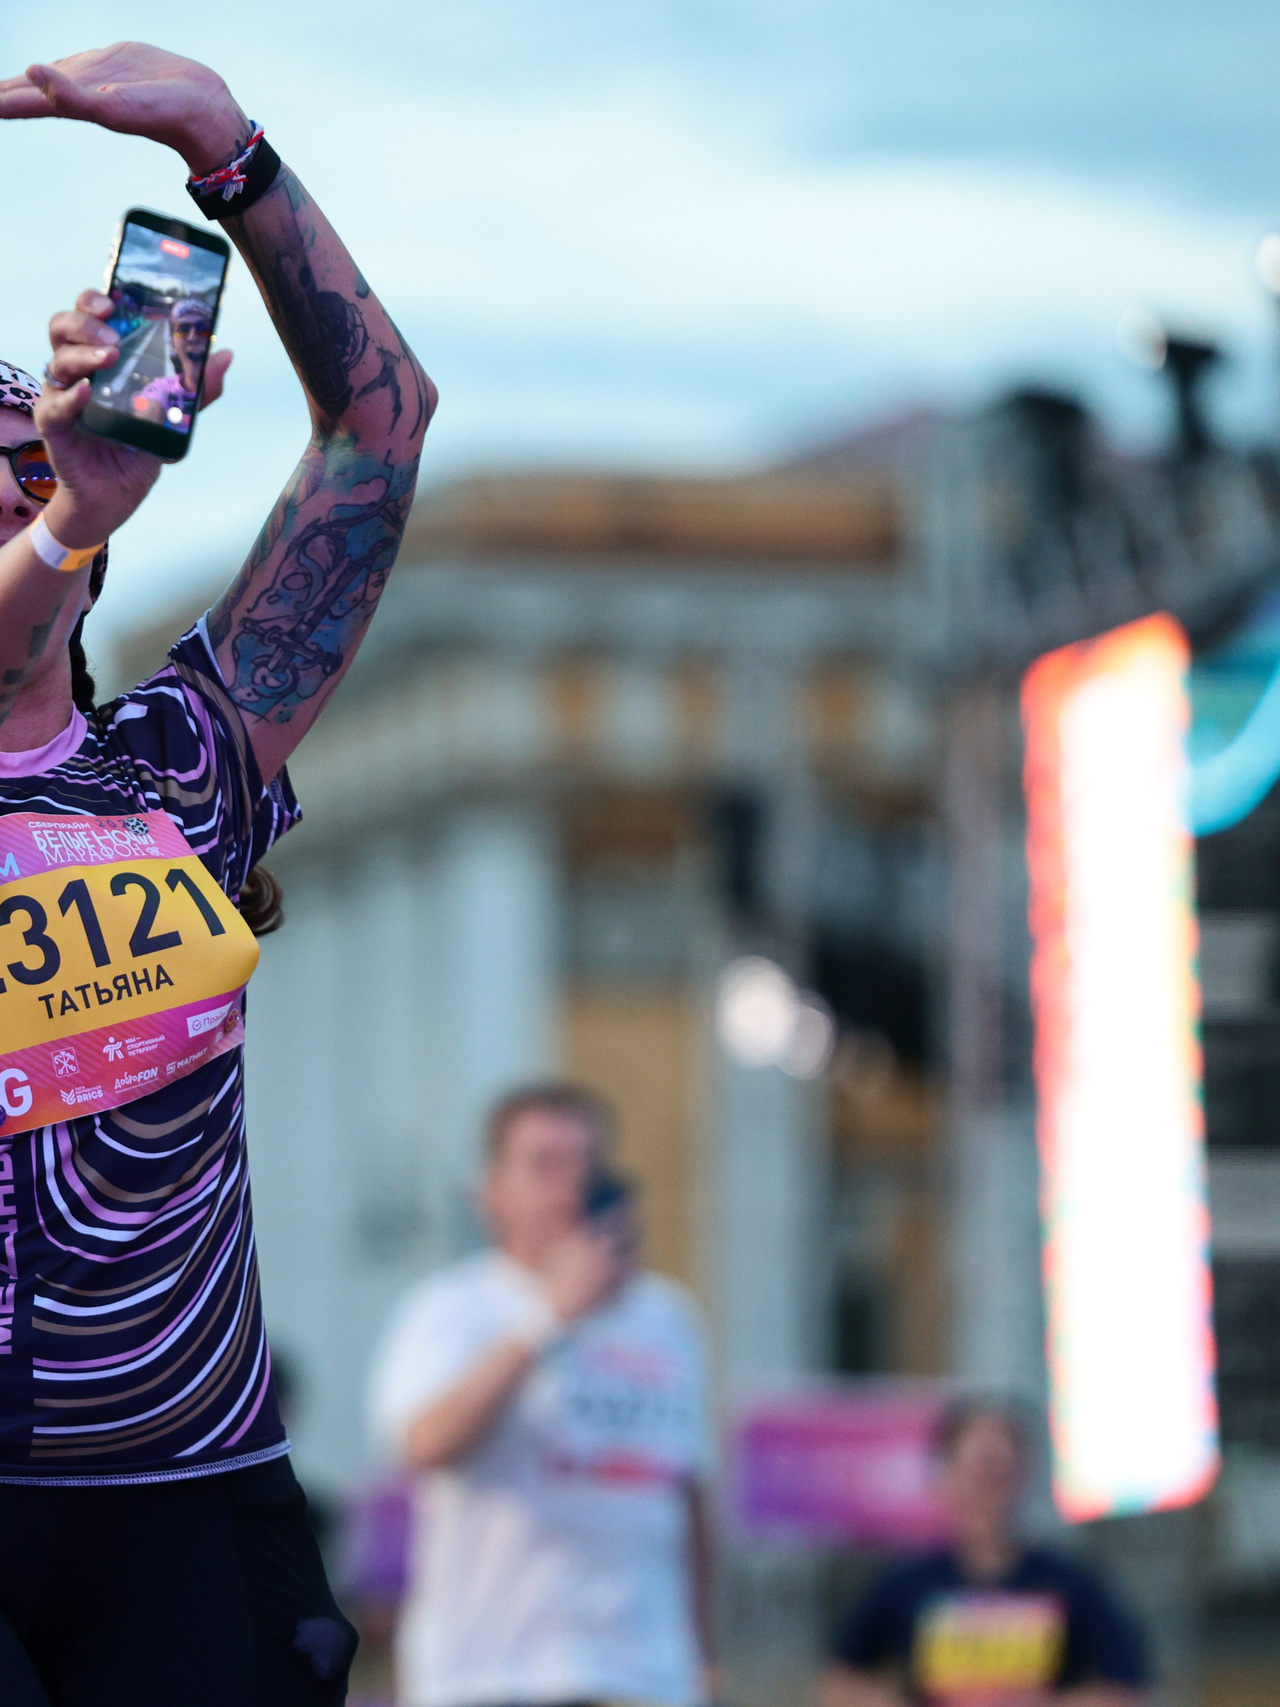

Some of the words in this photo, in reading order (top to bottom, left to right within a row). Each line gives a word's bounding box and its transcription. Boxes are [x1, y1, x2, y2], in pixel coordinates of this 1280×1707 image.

[28, 821, 91, 829] СБЕРПРАЙМ
[94, 819, 127, 828] 202
[32, 830, 95, 851] БЕЛЫЕ
[43, 844, 147, 866] МАРАФОН
[38, 964, 174, 1019] ТАТЬЯНА
[177, 1047, 208, 1069] МАГНИТ
[76, 1090, 104, 1103] BRICS
